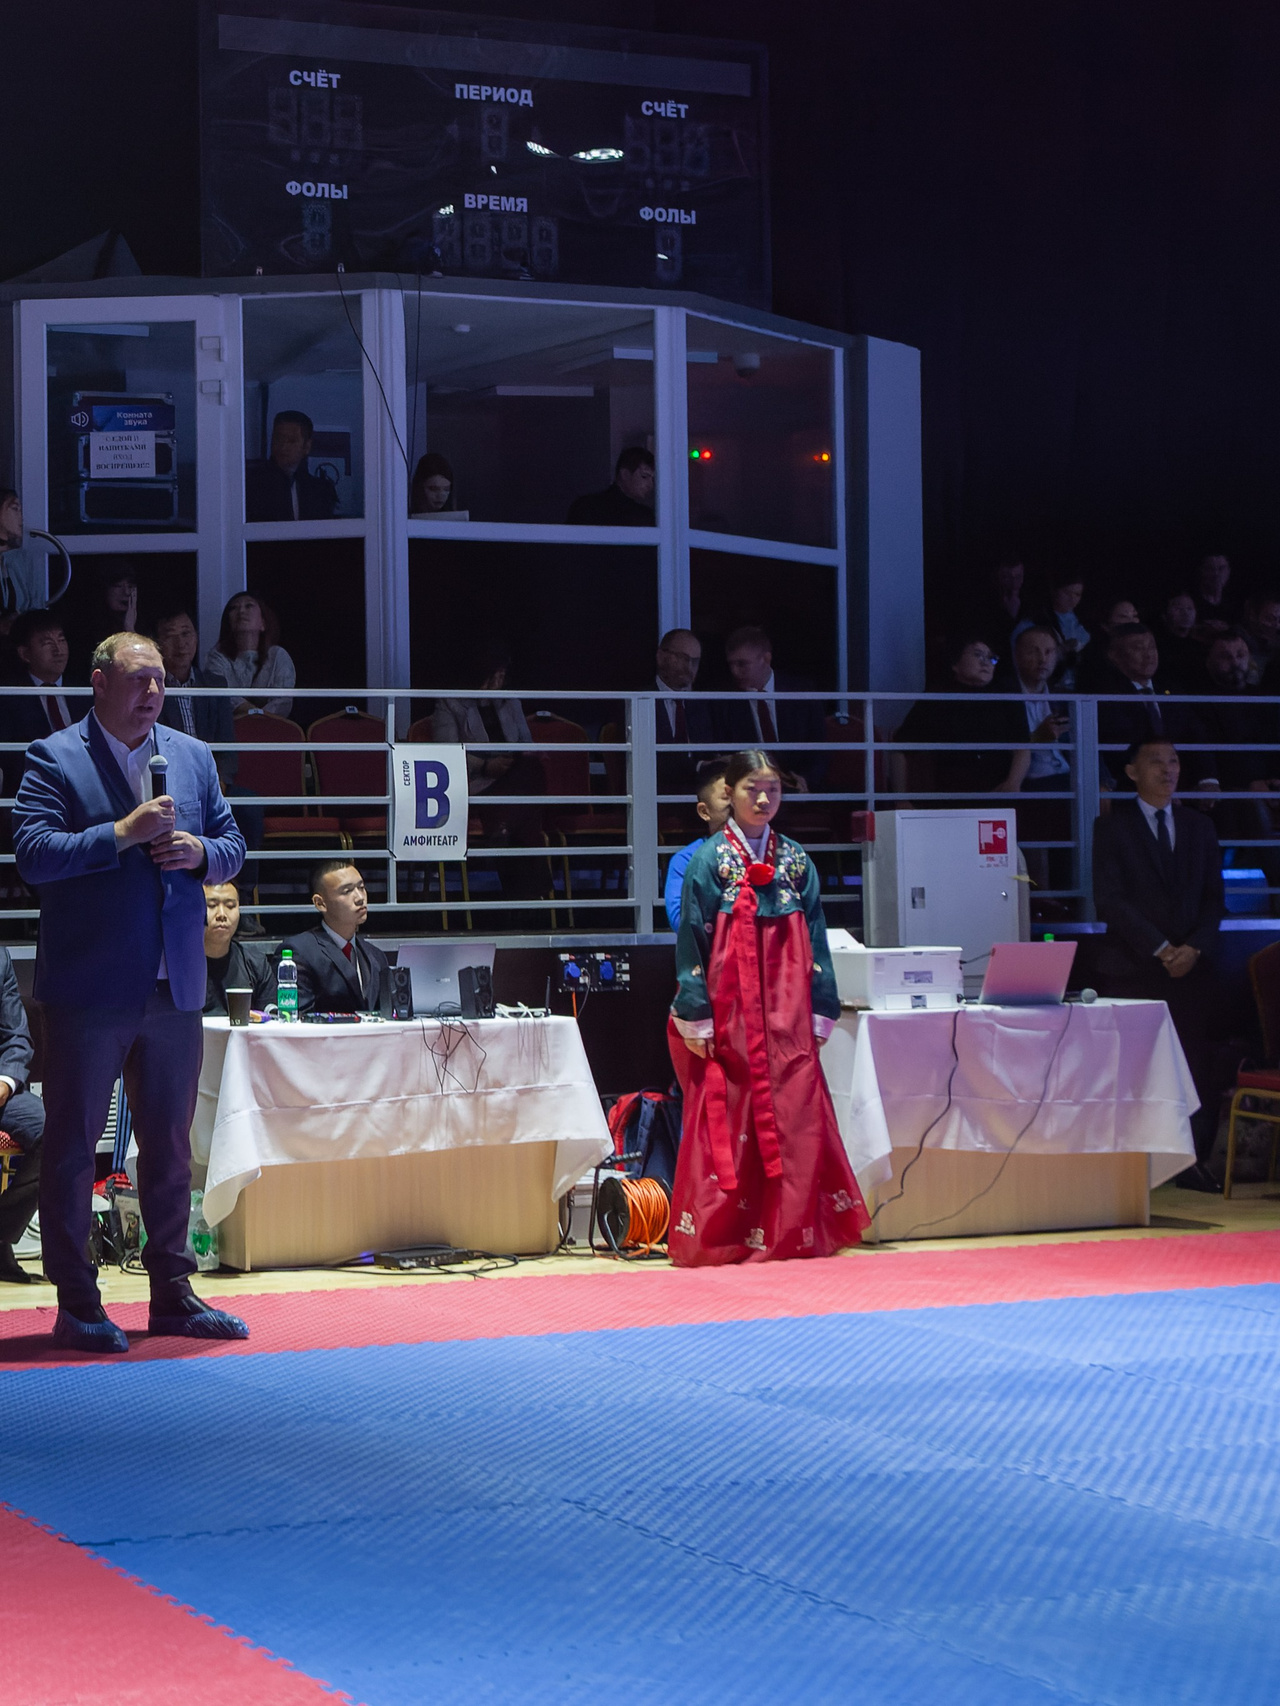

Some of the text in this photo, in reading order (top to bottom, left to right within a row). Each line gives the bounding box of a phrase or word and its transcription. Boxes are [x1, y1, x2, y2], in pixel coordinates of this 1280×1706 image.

[289, 69, 341, 89] СЧЁТ
[455, 83, 534, 108] ПЕРИОД
[641, 100, 689, 119] СЧЁТ
[285, 180, 348, 200] ФОЛЫ
[464, 193, 528, 213] ВРЕМЯ
[639, 206, 697, 225] ФОЛЫ
[402, 760, 411, 787] СЕКТОР
[403, 835, 458, 846] АМФИТЕАТР
